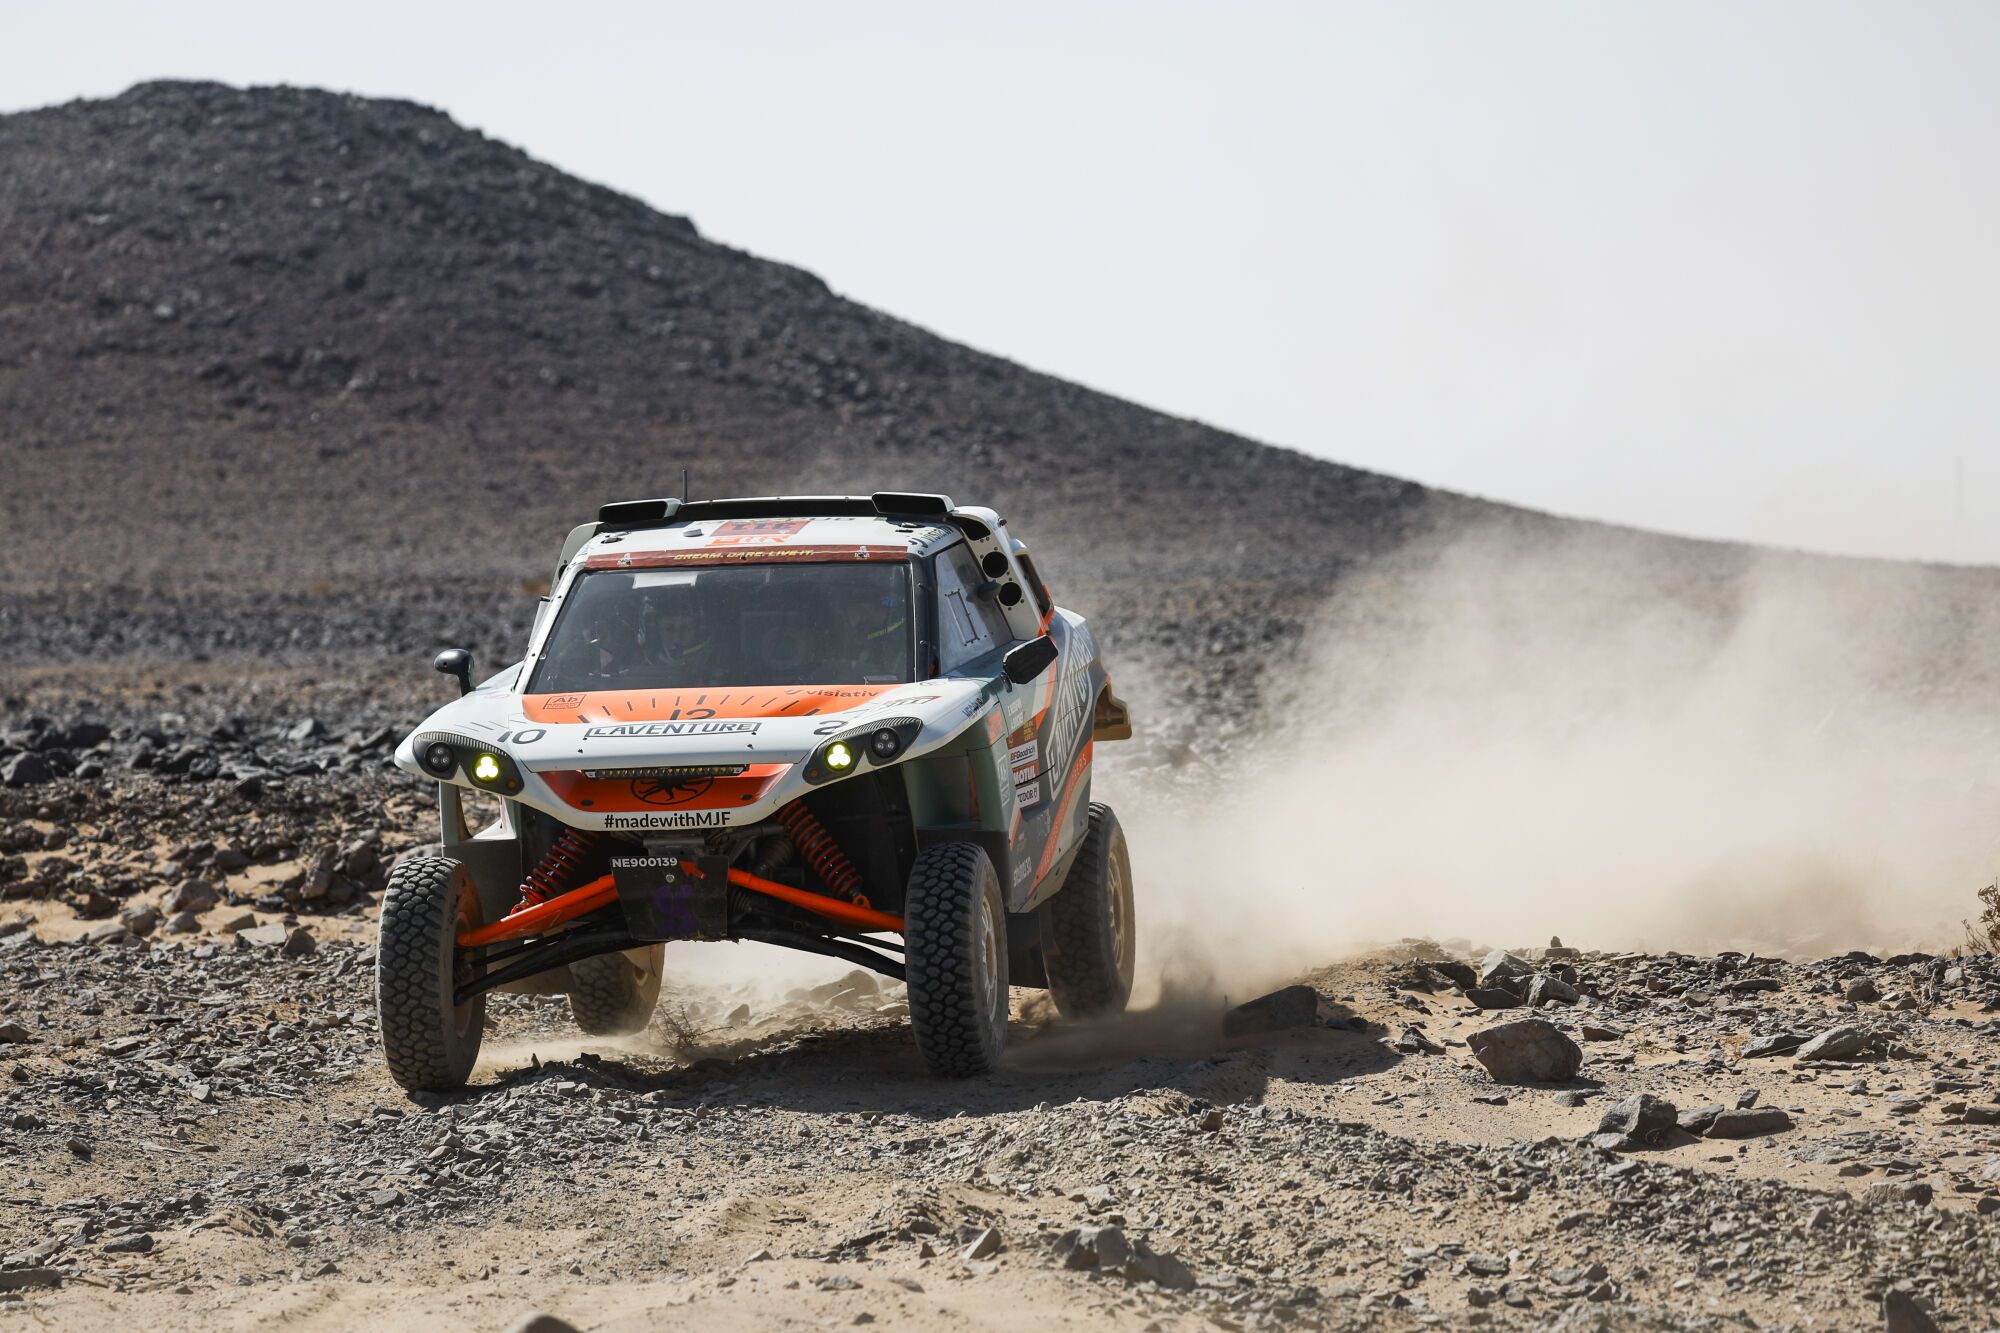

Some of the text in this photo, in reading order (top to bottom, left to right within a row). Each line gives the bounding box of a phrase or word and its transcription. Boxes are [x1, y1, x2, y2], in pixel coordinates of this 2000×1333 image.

[674, 552, 724, 560] DREAM.
[806, 689, 880, 698] visiativ
[593, 722, 755, 735] LAVENTURE
[813, 720, 848, 736] 2
[496, 728, 547, 745] 10
[1010, 746, 1036, 761] BFGoodrich
[1013, 765, 1036, 785] MOTUL
[1017, 789, 1034, 803] TUDOR
[604, 811, 731, 829] #madewithMJF
[611, 857, 678, 868] NE900139
